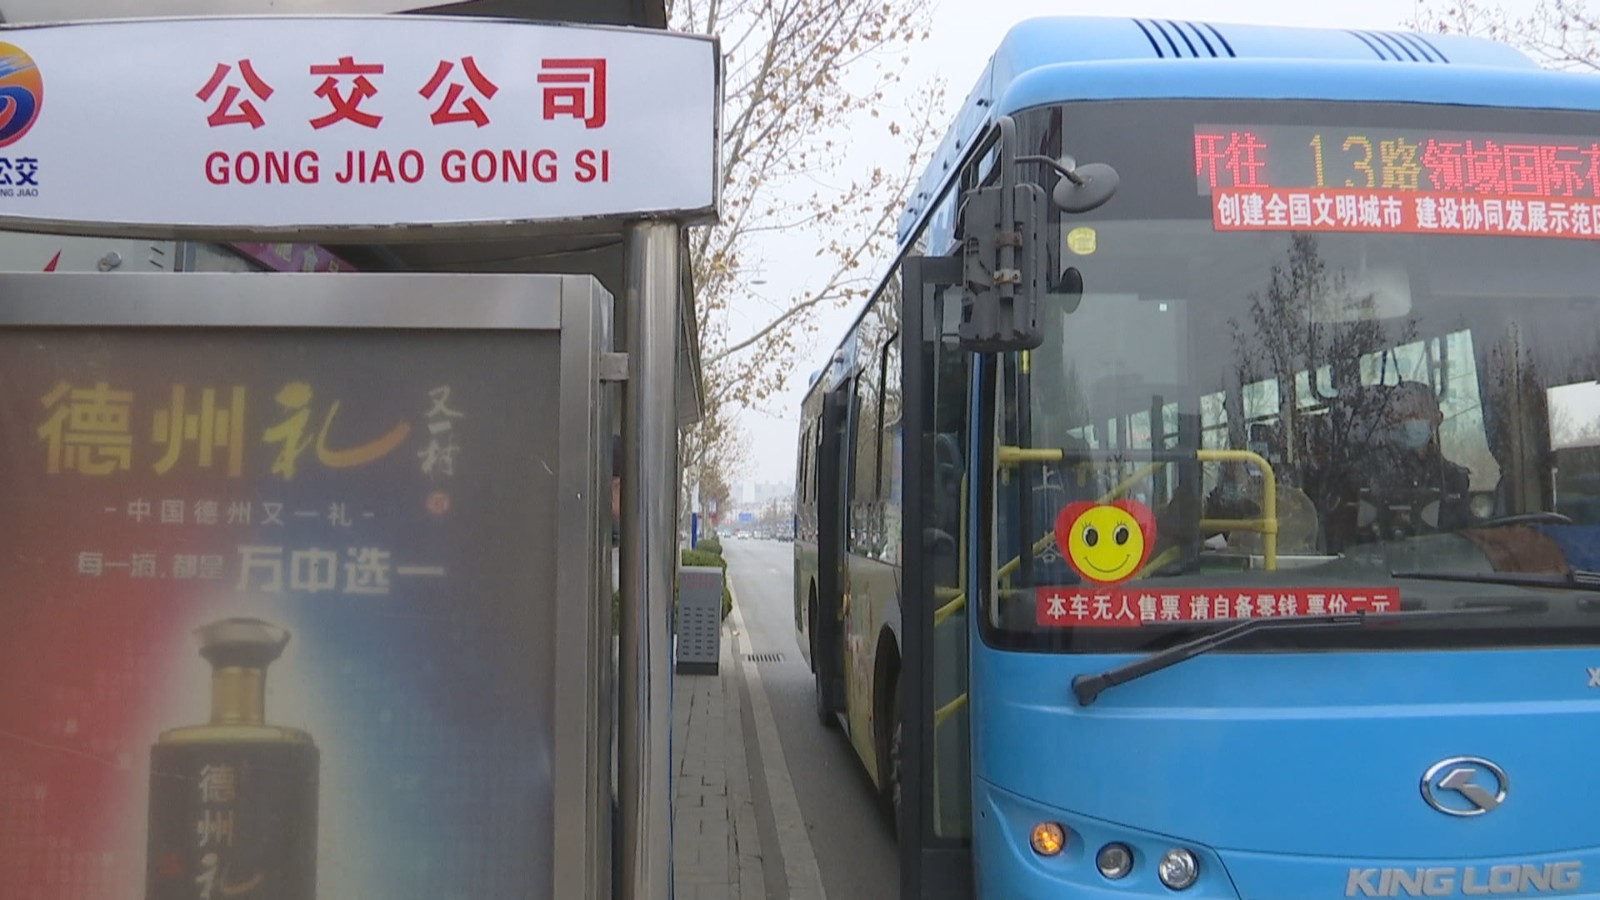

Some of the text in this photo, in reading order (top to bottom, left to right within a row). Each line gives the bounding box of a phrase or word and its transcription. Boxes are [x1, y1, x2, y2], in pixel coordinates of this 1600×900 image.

[196, 56, 607, 129] 公交公司
[204, 149, 610, 185] GONG JIAO GONG SI
[1194, 131, 1270, 189] 开往
[16, 188, 39, 198] JIAO
[1217, 192, 1403, 229] 创建全国文明城市
[37, 380, 411, 480] 德州礼
[1046, 592, 1181, 622] 本车无人售票
[1189, 593, 1298, 620] 请自备零钱
[1344, 861, 1583, 898] KING LONG
